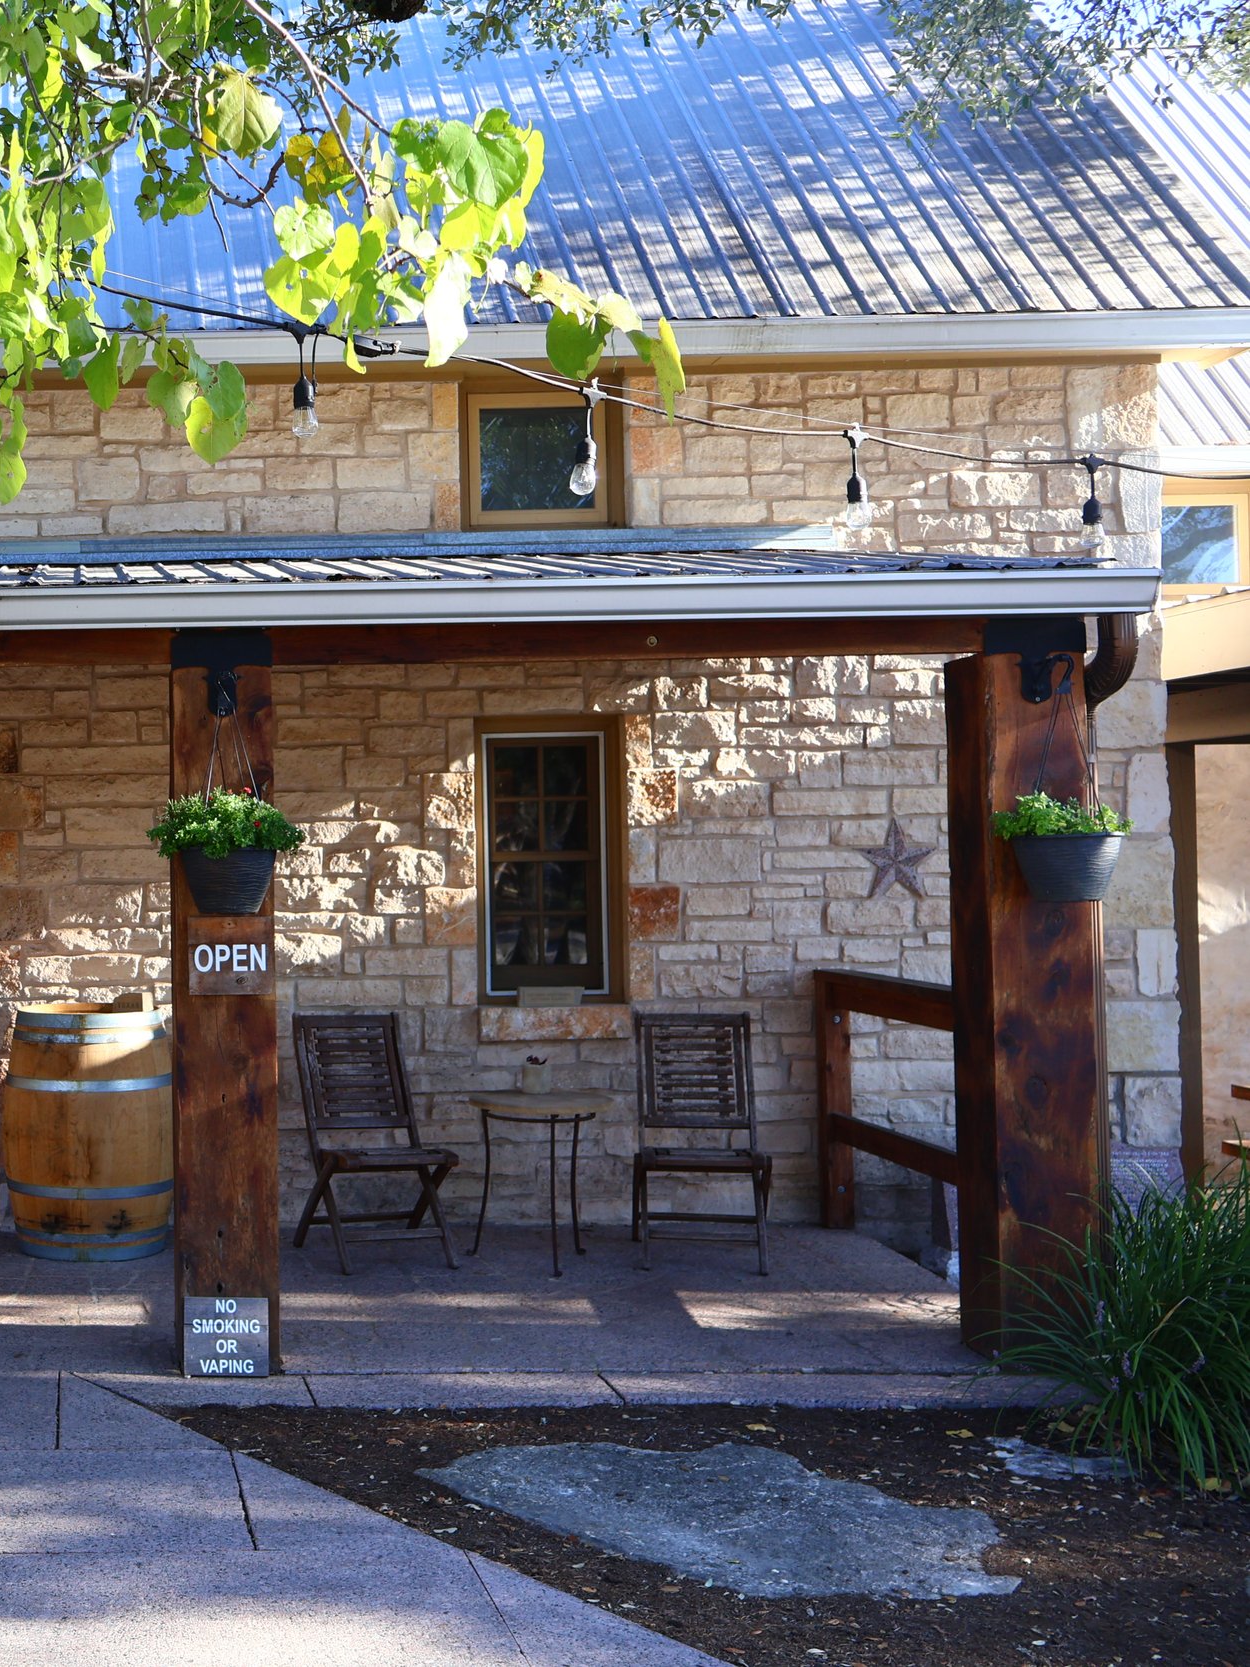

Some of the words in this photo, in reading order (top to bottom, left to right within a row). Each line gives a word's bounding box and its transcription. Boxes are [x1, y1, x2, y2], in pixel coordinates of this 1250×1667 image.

[194, 944, 267, 972] OPEN
[215, 1299, 237, 1313] NO
[191, 1318, 261, 1334] SMOKING
[215, 1339, 238, 1354] OR
[199, 1359, 255, 1374] VAPING
